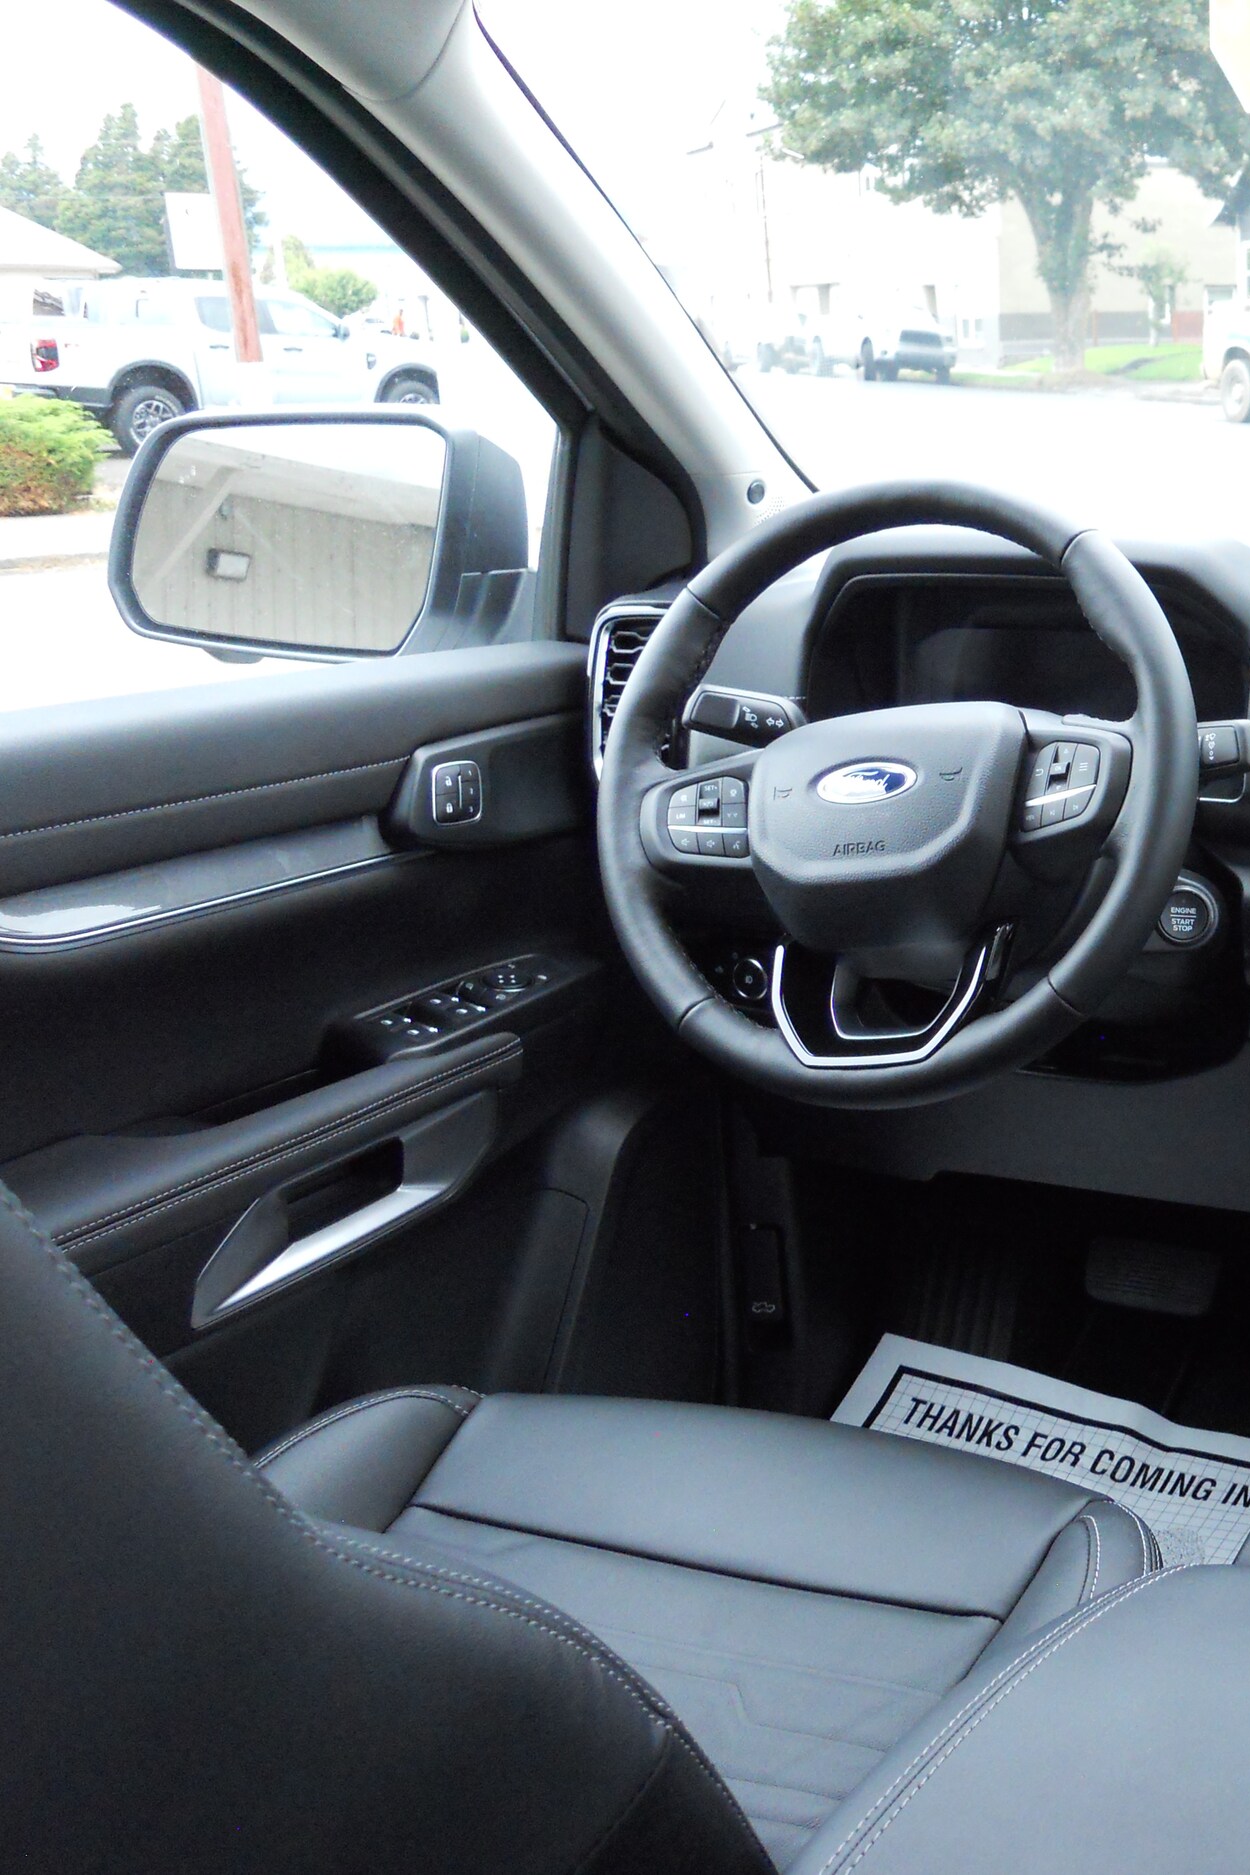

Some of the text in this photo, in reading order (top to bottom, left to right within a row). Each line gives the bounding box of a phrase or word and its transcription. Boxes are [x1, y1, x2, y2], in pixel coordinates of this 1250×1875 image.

[833, 840, 886, 857] AIRBAG
[1170, 906, 1197, 915] ENGINE
[1171, 918, 1195, 926] START
[1172, 924, 1193, 932] STOP
[903, 1397, 1020, 1453] THANKS
[1022, 1431, 1087, 1468] FOR
[1089, 1448, 1218, 1502] COMING
